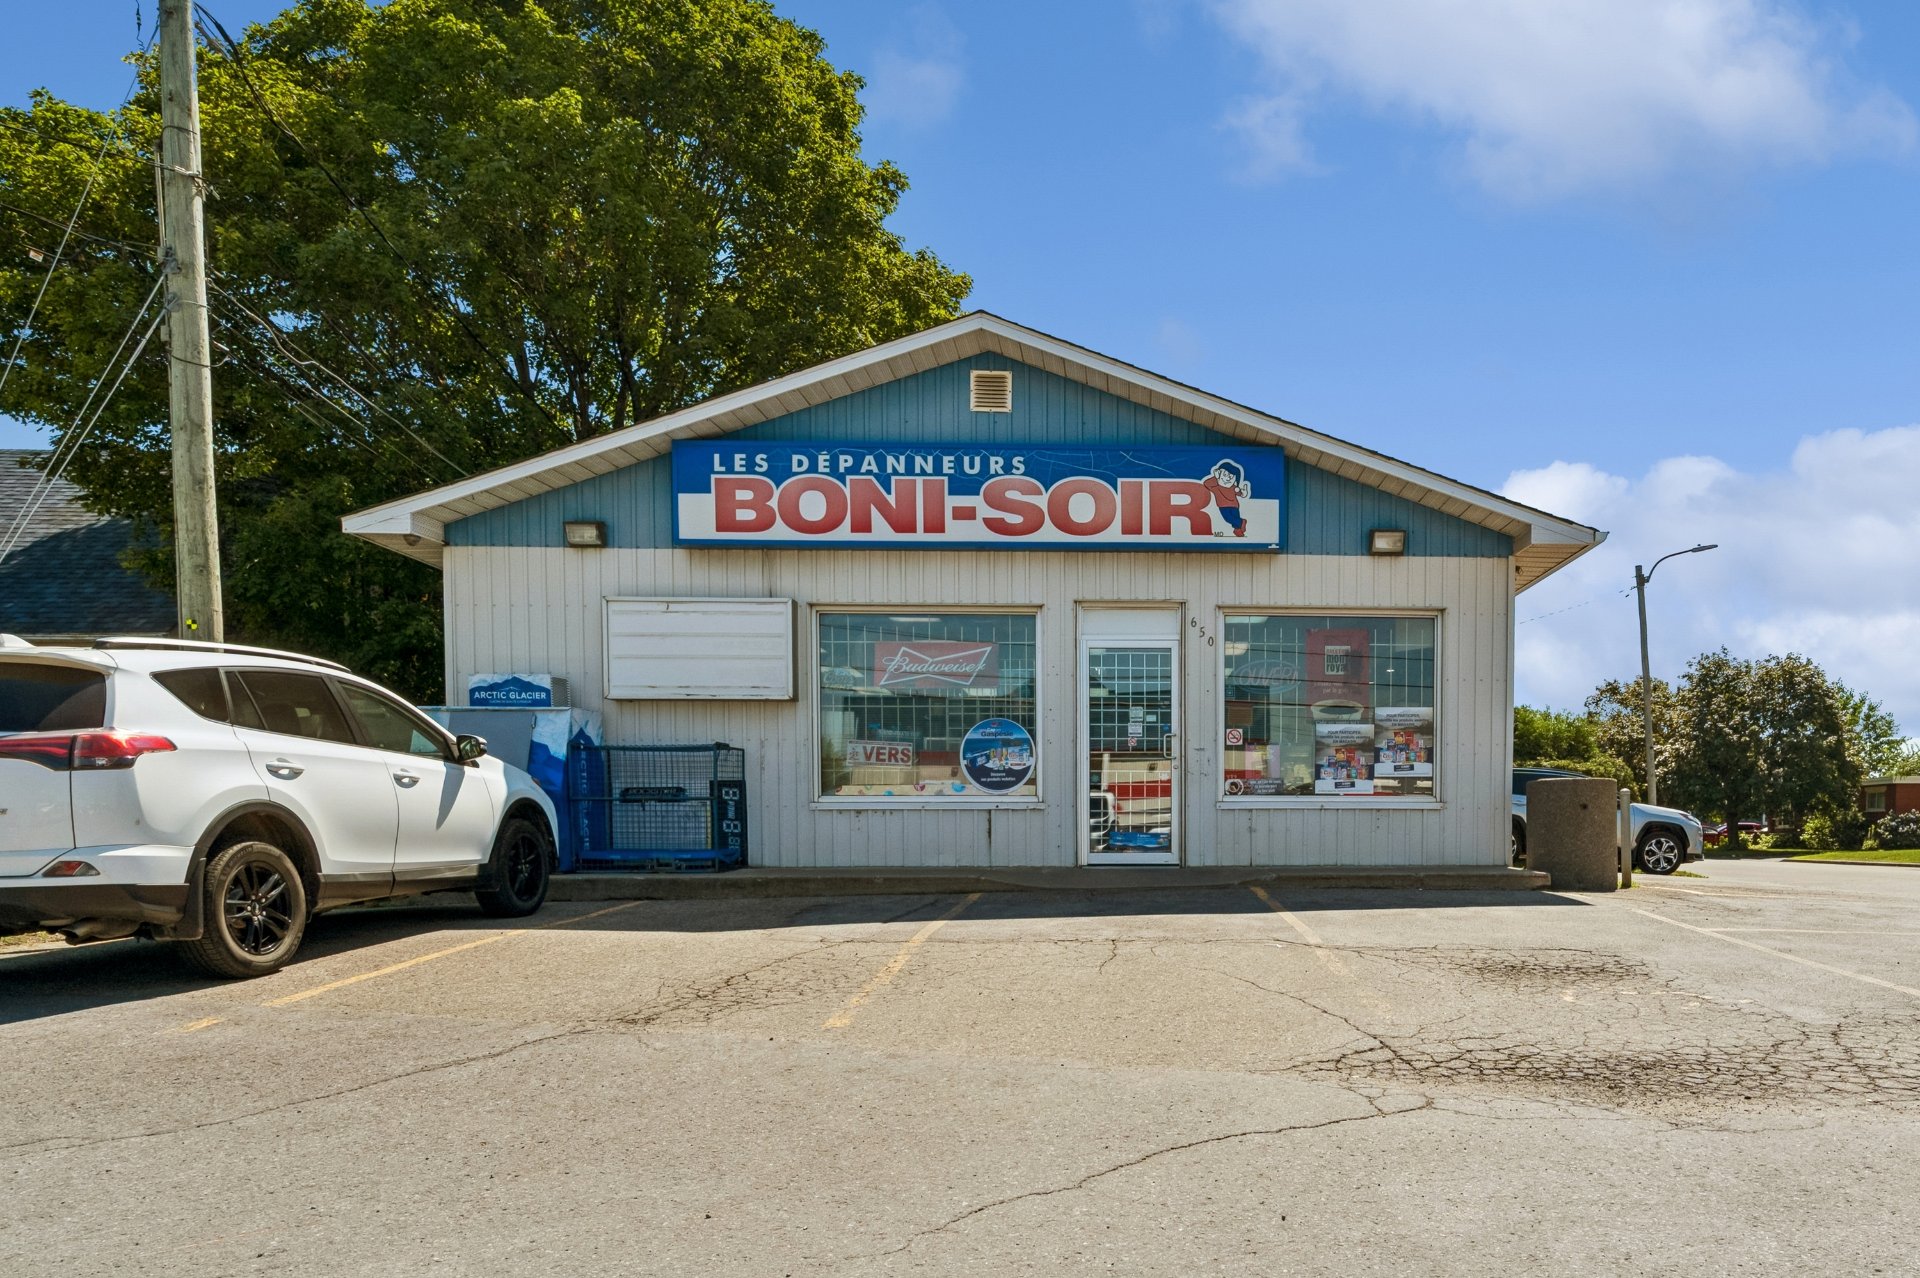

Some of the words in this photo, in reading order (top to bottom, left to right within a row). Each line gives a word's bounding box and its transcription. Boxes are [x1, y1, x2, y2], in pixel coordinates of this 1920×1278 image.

[713, 452, 770, 473] LES
[791, 450, 1027, 475] DÉPANNEURS
[713, 474, 1213, 537] BONI-SOIR
[882, 656, 986, 674] Budweiser
[473, 691, 507, 699] ARCTIC
[509, 691, 547, 700] GLACIER
[862, 745, 911, 764] VERS
